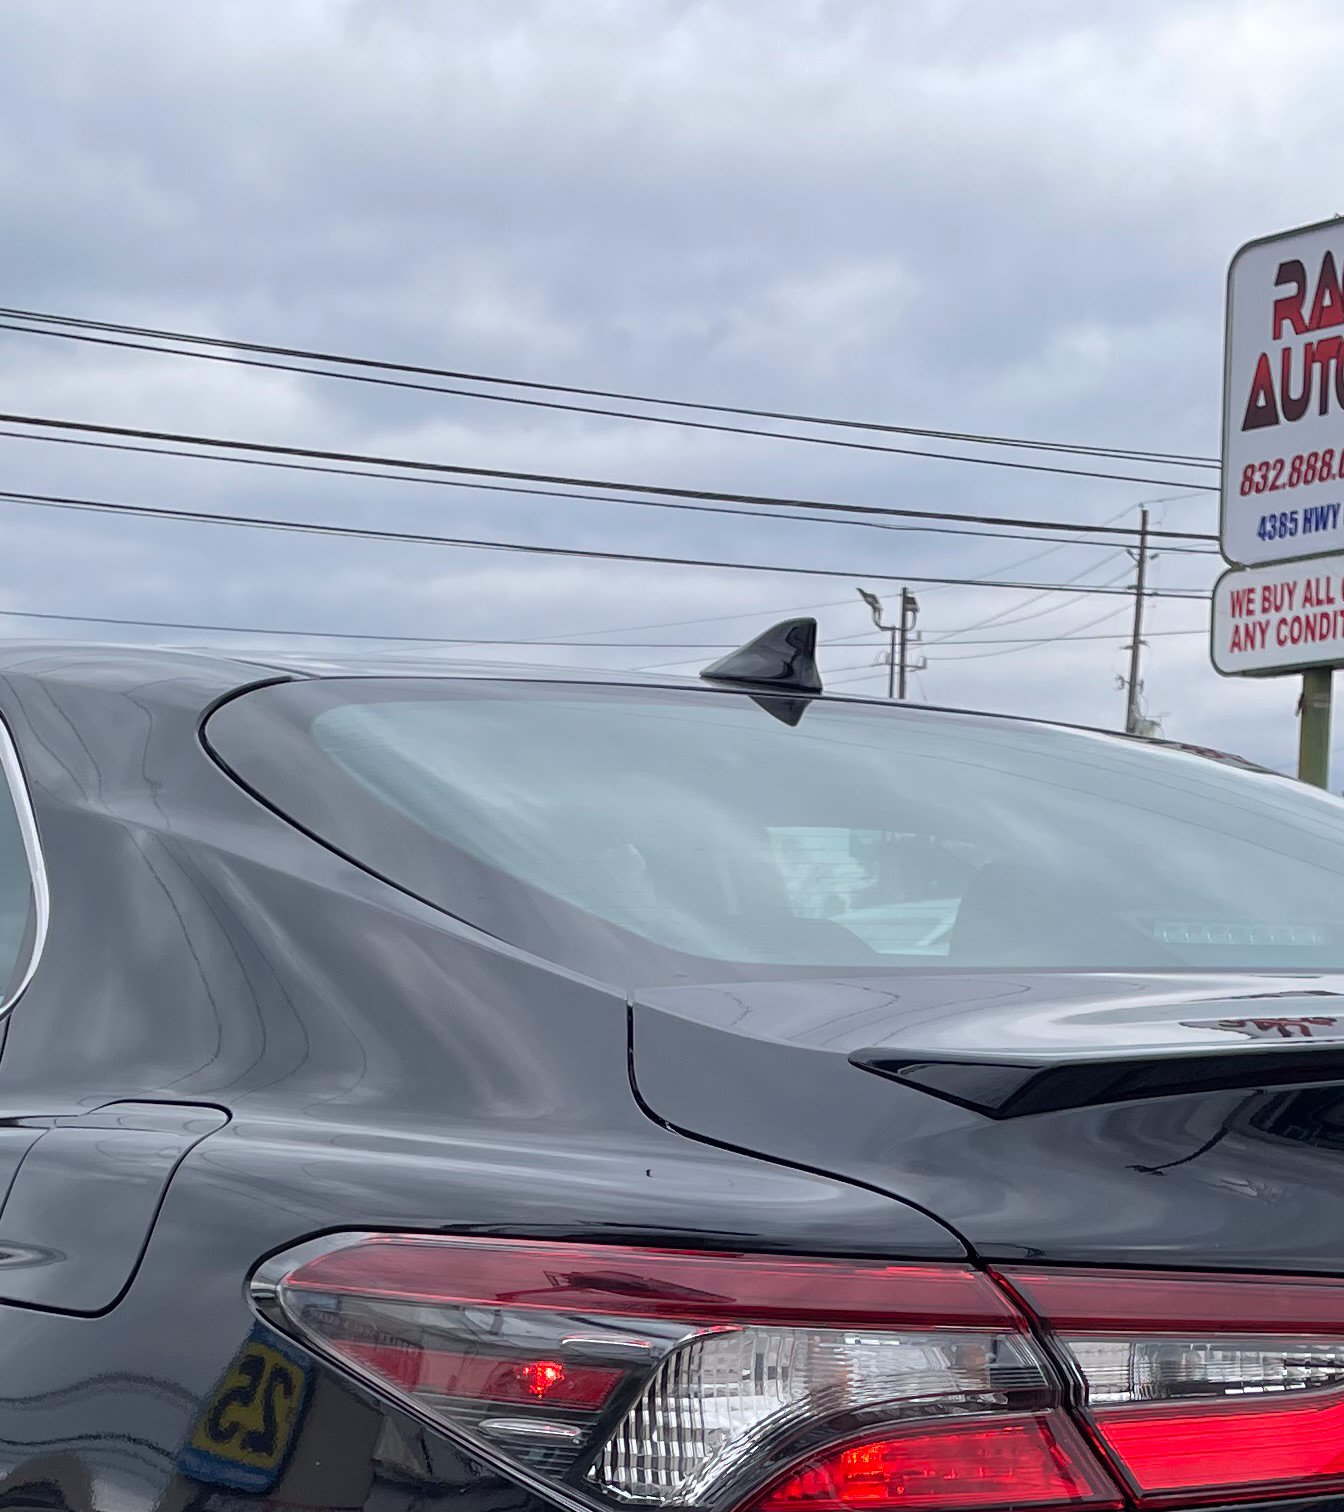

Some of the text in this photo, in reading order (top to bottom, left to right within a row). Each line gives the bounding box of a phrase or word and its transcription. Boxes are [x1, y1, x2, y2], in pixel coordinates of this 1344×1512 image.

[1257, 509, 1299, 542] 4385
[1302, 502, 1342, 535] HWY
[1230, 587, 1257, 619] WE
[1260, 580, 1298, 615] BUY
[1302, 575, 1336, 609] ALL
[1229, 619, 1271, 654] ANY
